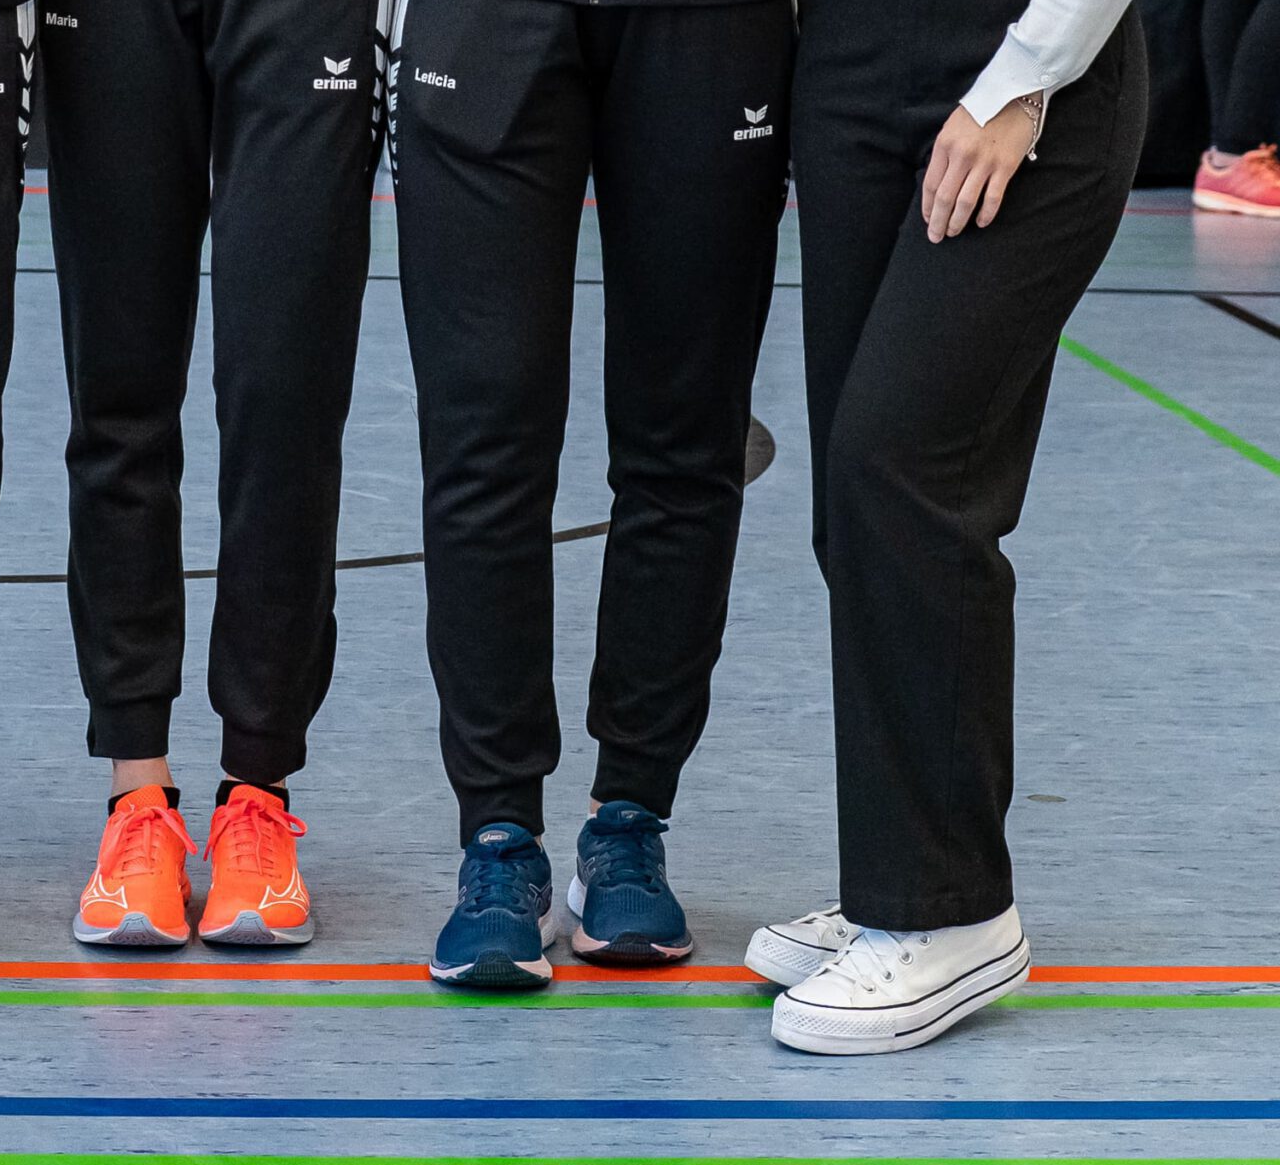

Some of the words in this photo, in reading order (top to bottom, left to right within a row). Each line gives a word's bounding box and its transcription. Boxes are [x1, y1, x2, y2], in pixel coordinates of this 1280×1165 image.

[45, 12, 78, 28] Maria
[313, 78, 357, 90] erima
[414, 67, 456, 90] Leticia
[733, 125, 773, 141] erima
